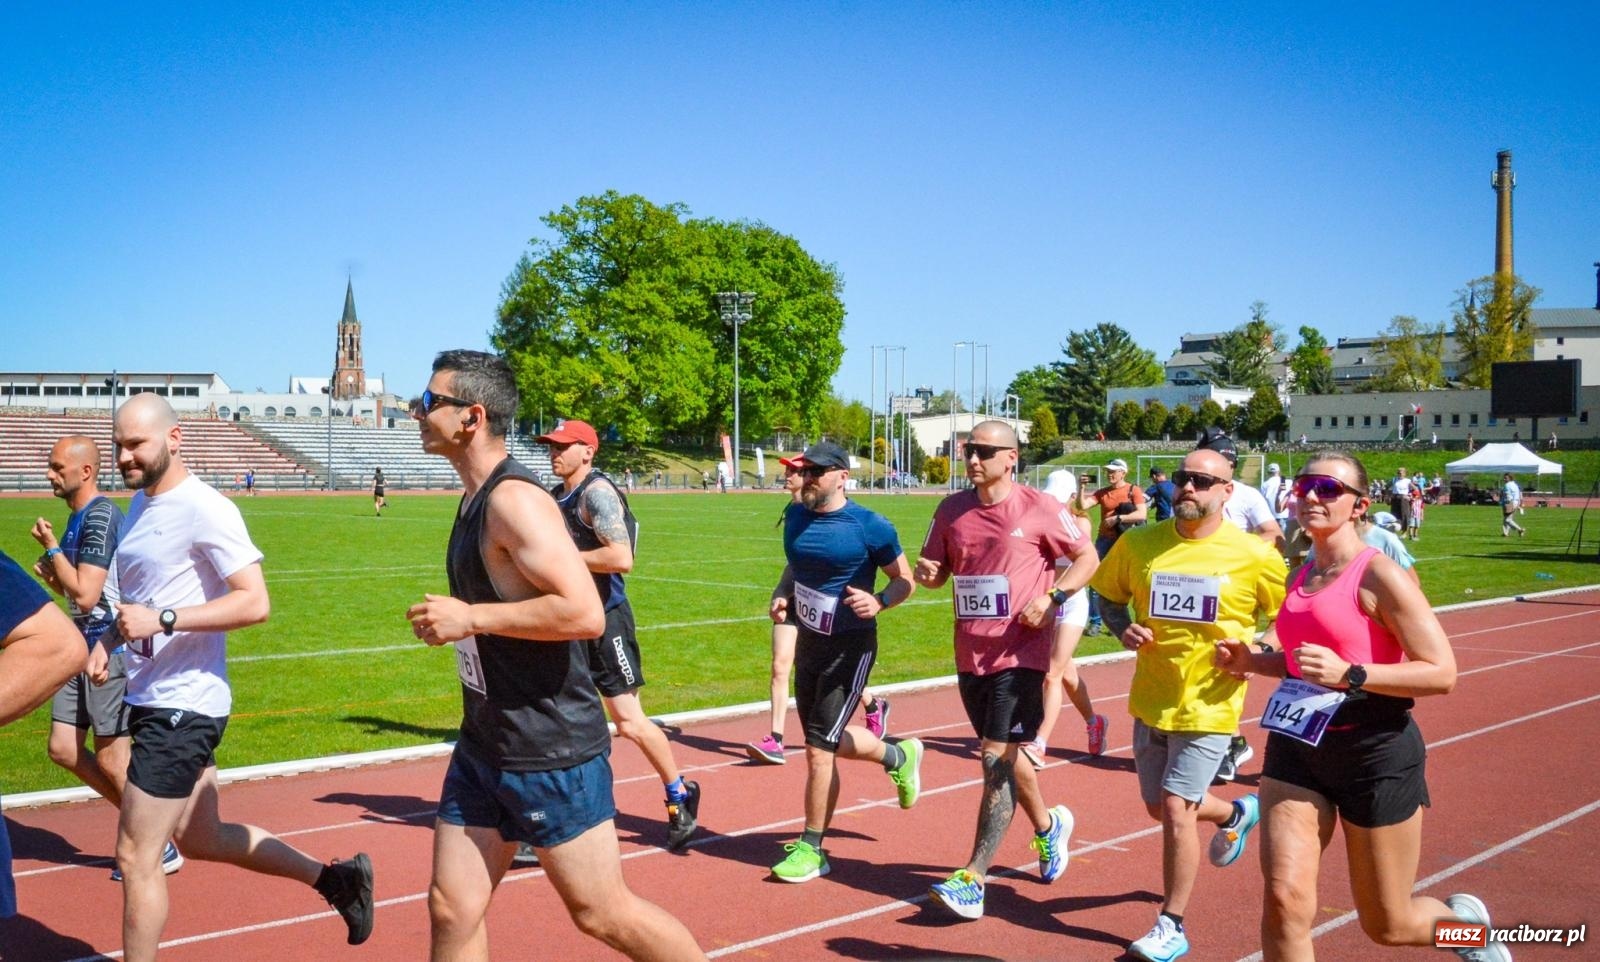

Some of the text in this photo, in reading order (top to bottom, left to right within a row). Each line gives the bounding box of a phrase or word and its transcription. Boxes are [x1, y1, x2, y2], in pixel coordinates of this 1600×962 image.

[798, 600, 818, 622] 106
[962, 595, 991, 611] 154
[1161, 593, 1196, 613] 124
[1269, 700, 1306, 727] 144
